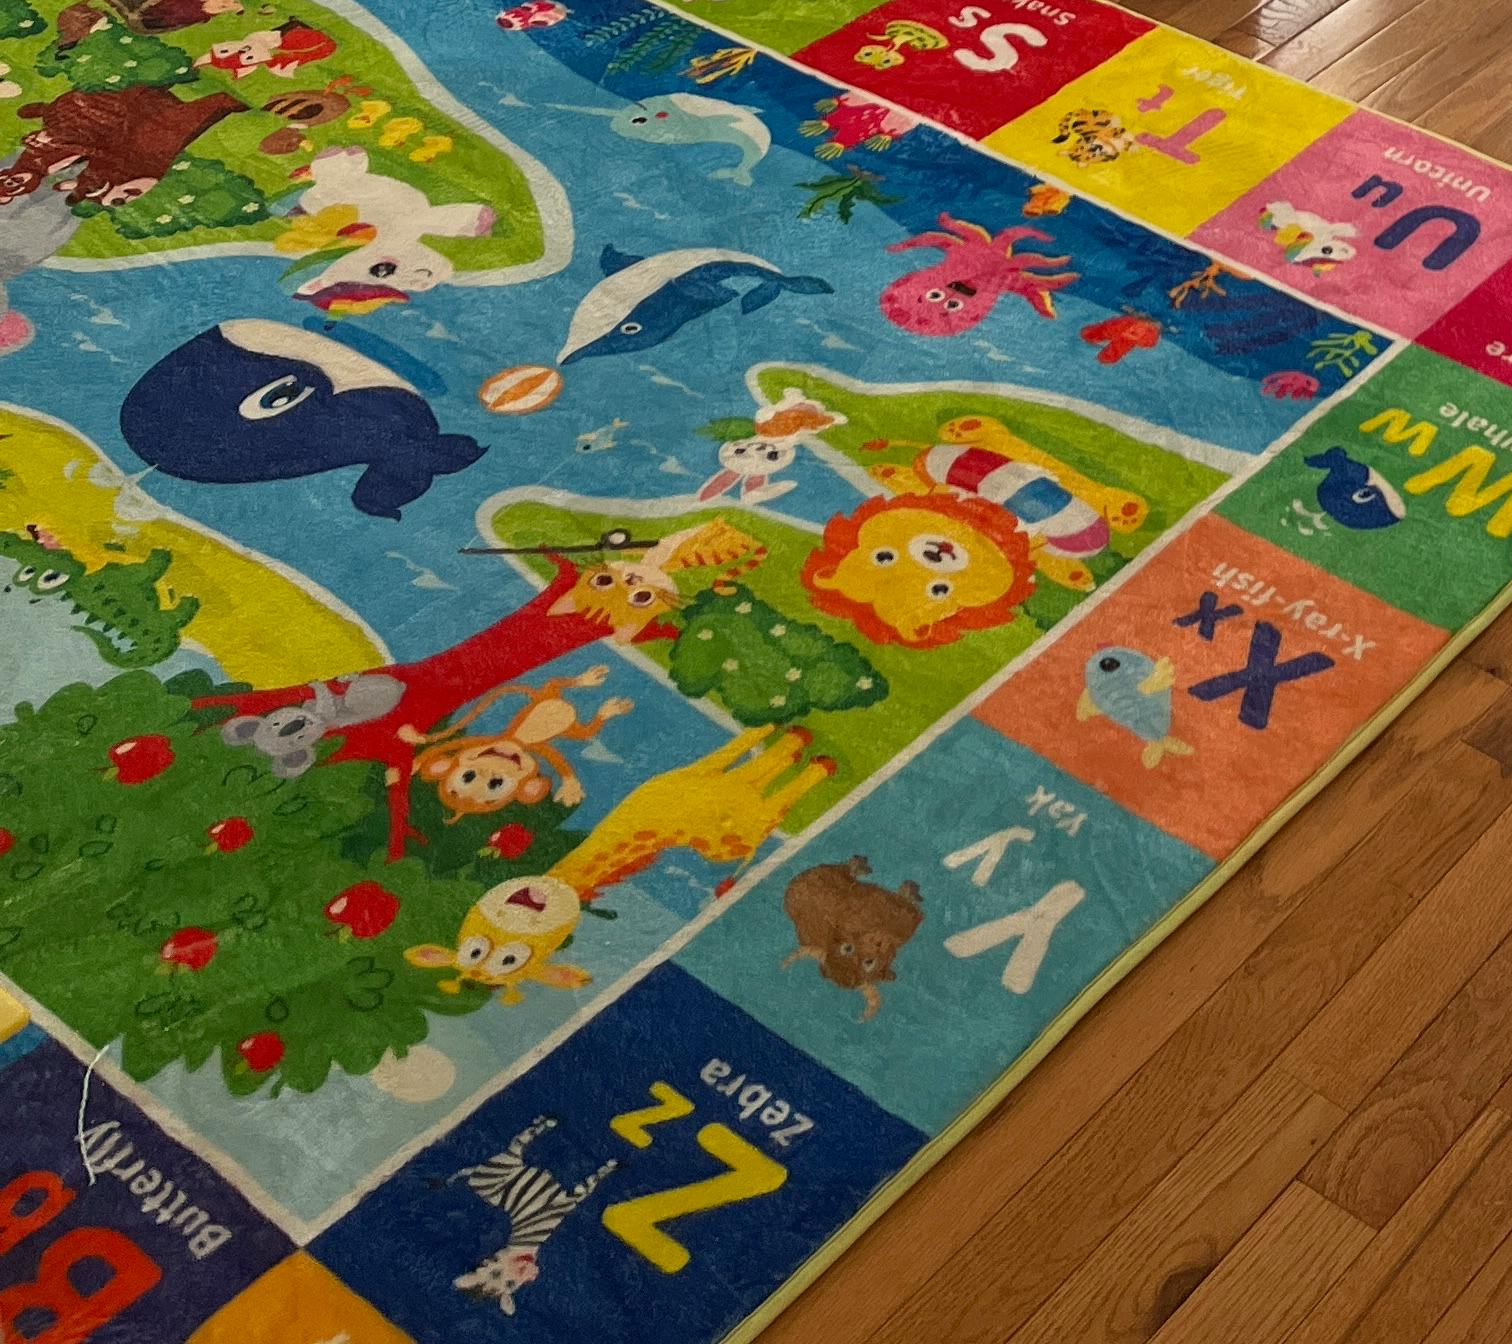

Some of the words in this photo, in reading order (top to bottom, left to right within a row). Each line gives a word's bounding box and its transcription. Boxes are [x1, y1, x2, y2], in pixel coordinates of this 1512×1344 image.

[948, 5, 1049, 74] Ss
[1136, 84, 1228, 165] Tt
[1351, 174, 1482, 272] Uu
[1382, 145, 1493, 204] Unicorn
[1210, 561, 1377, 661] X-ray-fish
[1172, 591, 1336, 730] Xx
[1025, 785, 1088, 837] Yak
[942, 826, 1087, 995] Yy
[700, 1058, 815, 1146] Zebra
[74, 1120, 233, 1261] Butterfly
[602, 1081, 788, 1275] Zz
